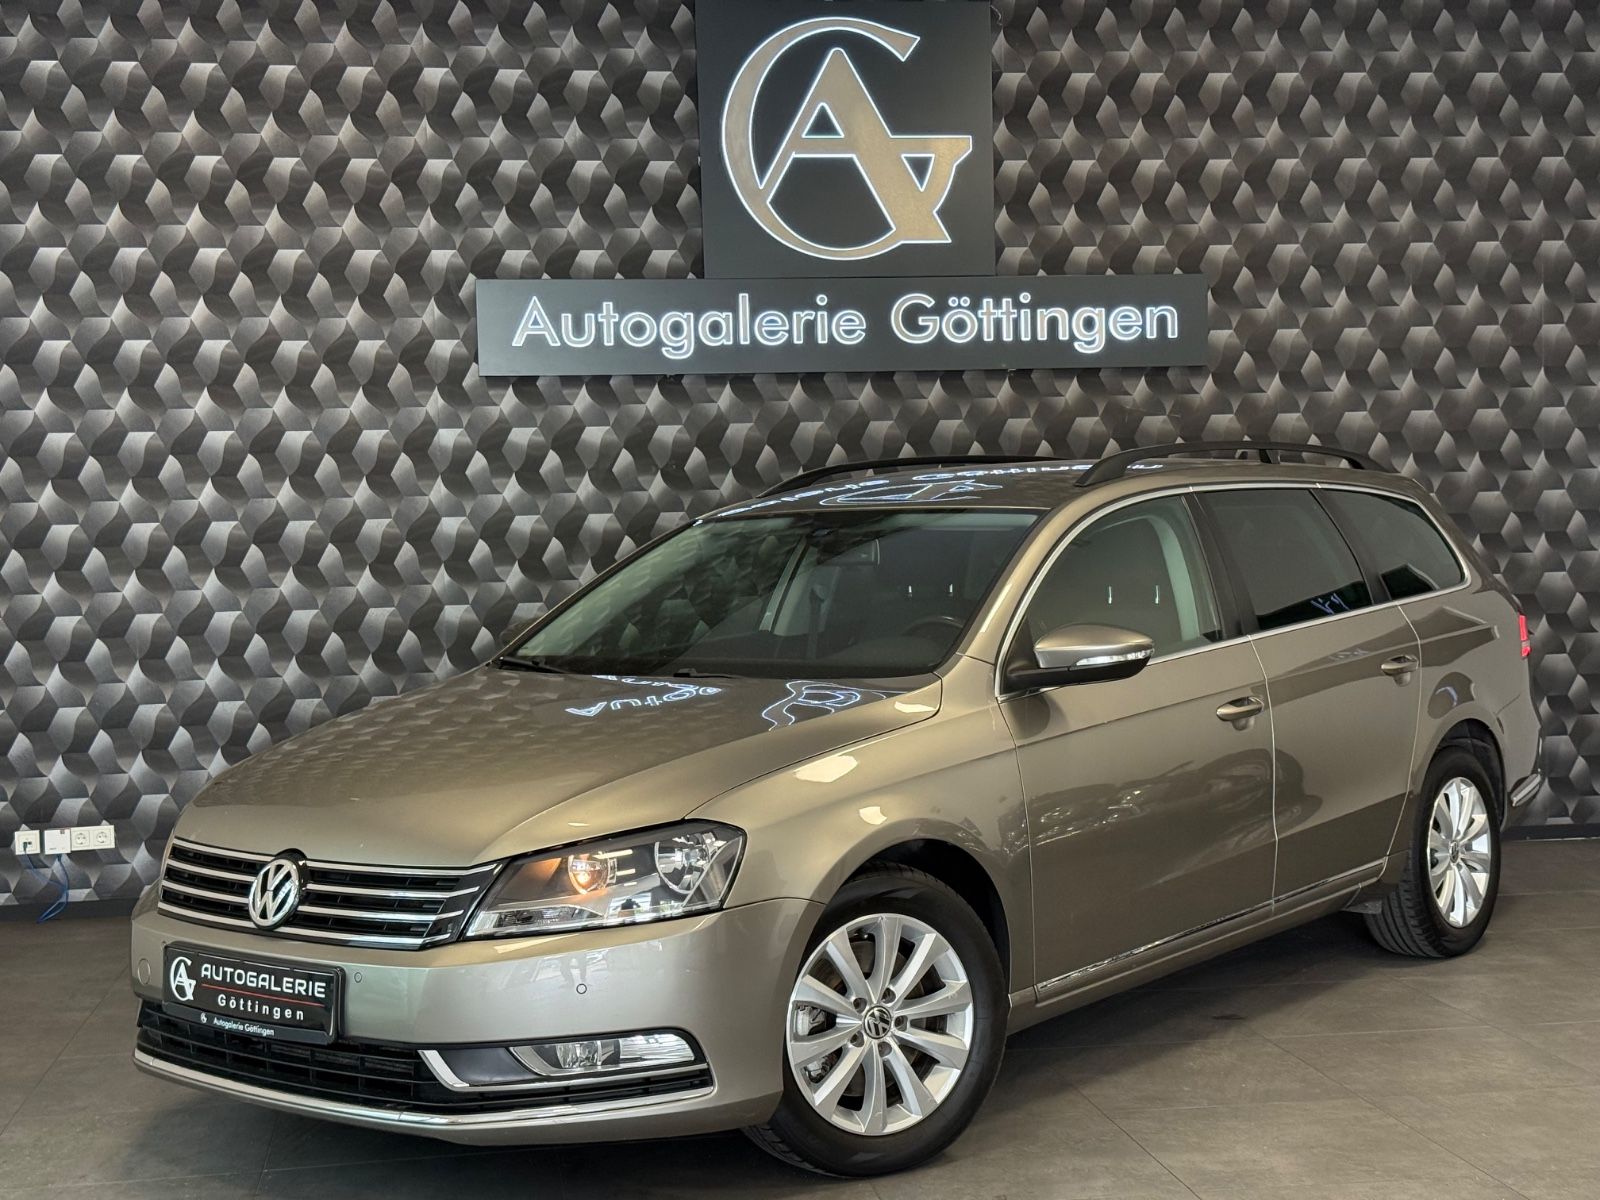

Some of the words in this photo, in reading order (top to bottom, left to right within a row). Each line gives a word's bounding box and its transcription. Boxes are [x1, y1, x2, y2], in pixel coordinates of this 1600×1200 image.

[511, 293, 867, 360] Autogalerie
[890, 292, 1179, 354] Göttingen
[200, 963, 326, 998] AUTOGALERIE
[217, 993, 304, 1020] Göttingen
